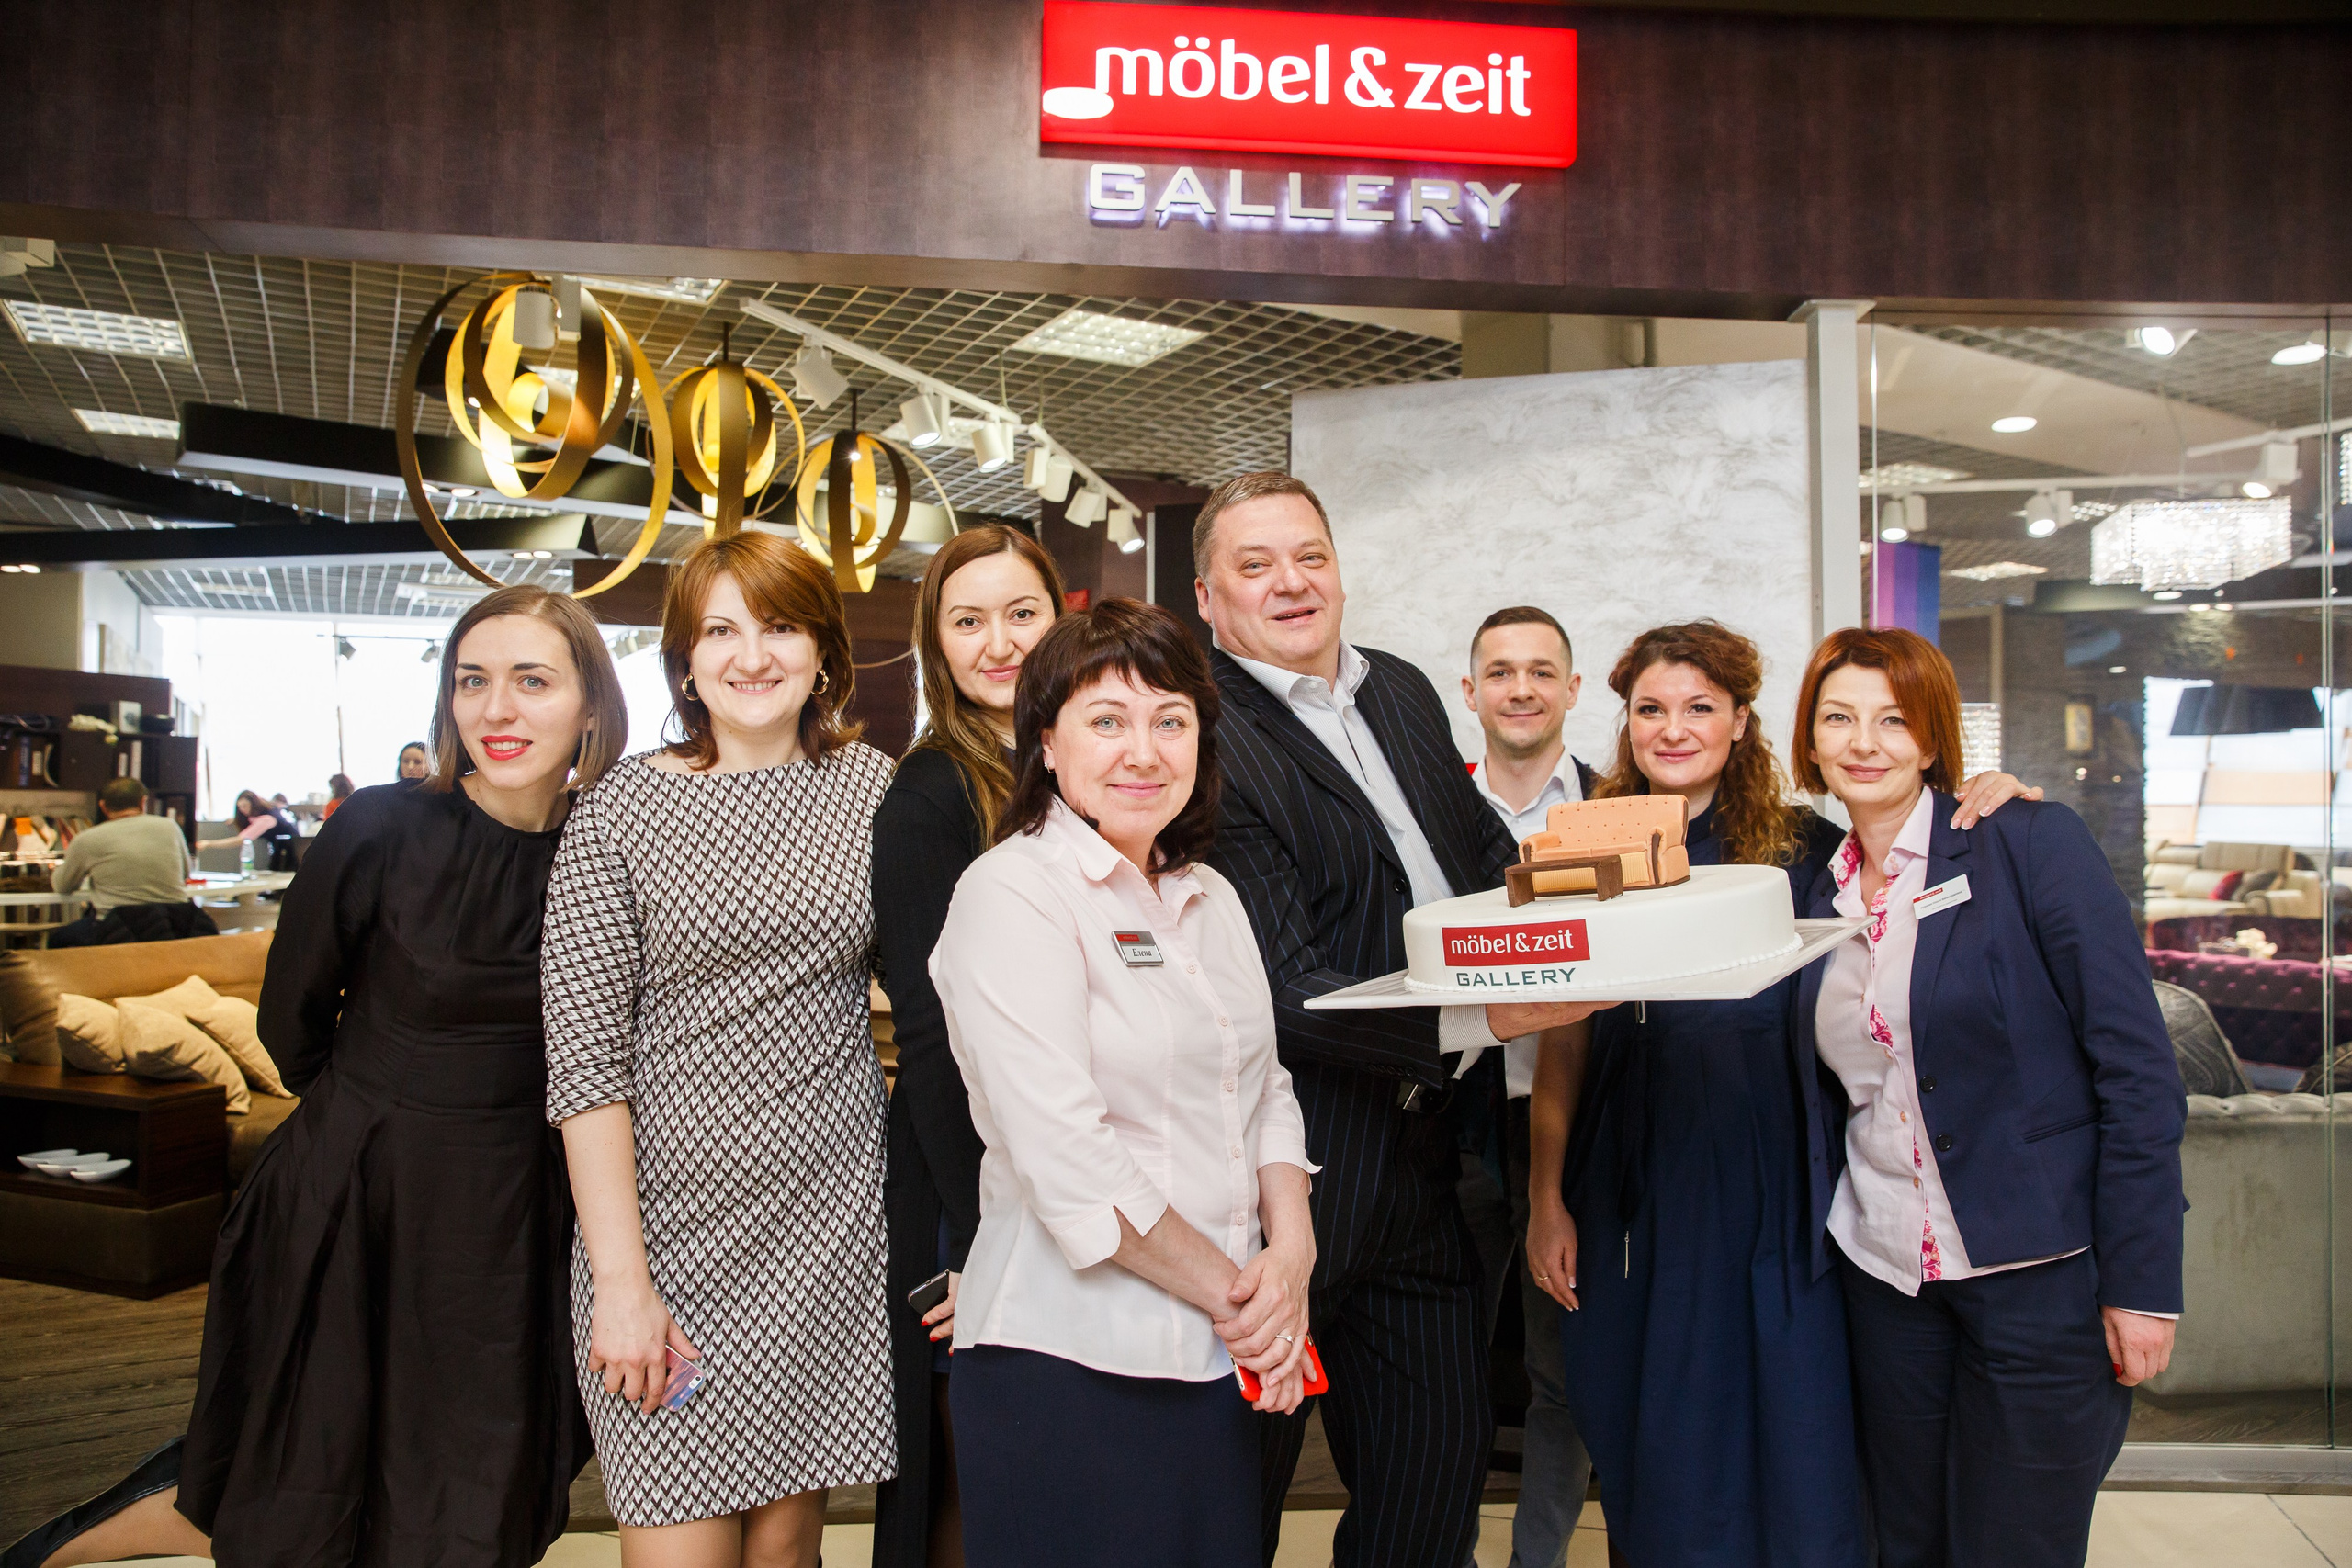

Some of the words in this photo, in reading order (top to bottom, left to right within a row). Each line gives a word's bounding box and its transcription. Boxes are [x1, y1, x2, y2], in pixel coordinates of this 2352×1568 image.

[1095, 35, 1329, 105] möbel
[1343, 46, 1396, 108] &
[1403, 52, 1532, 117] zeit
[1089, 163, 1522, 229] GALLERY
[1451, 932, 1511, 954] möbel
[1532, 929, 1575, 952] zeit
[1455, 967, 1576, 987] GALLERY
